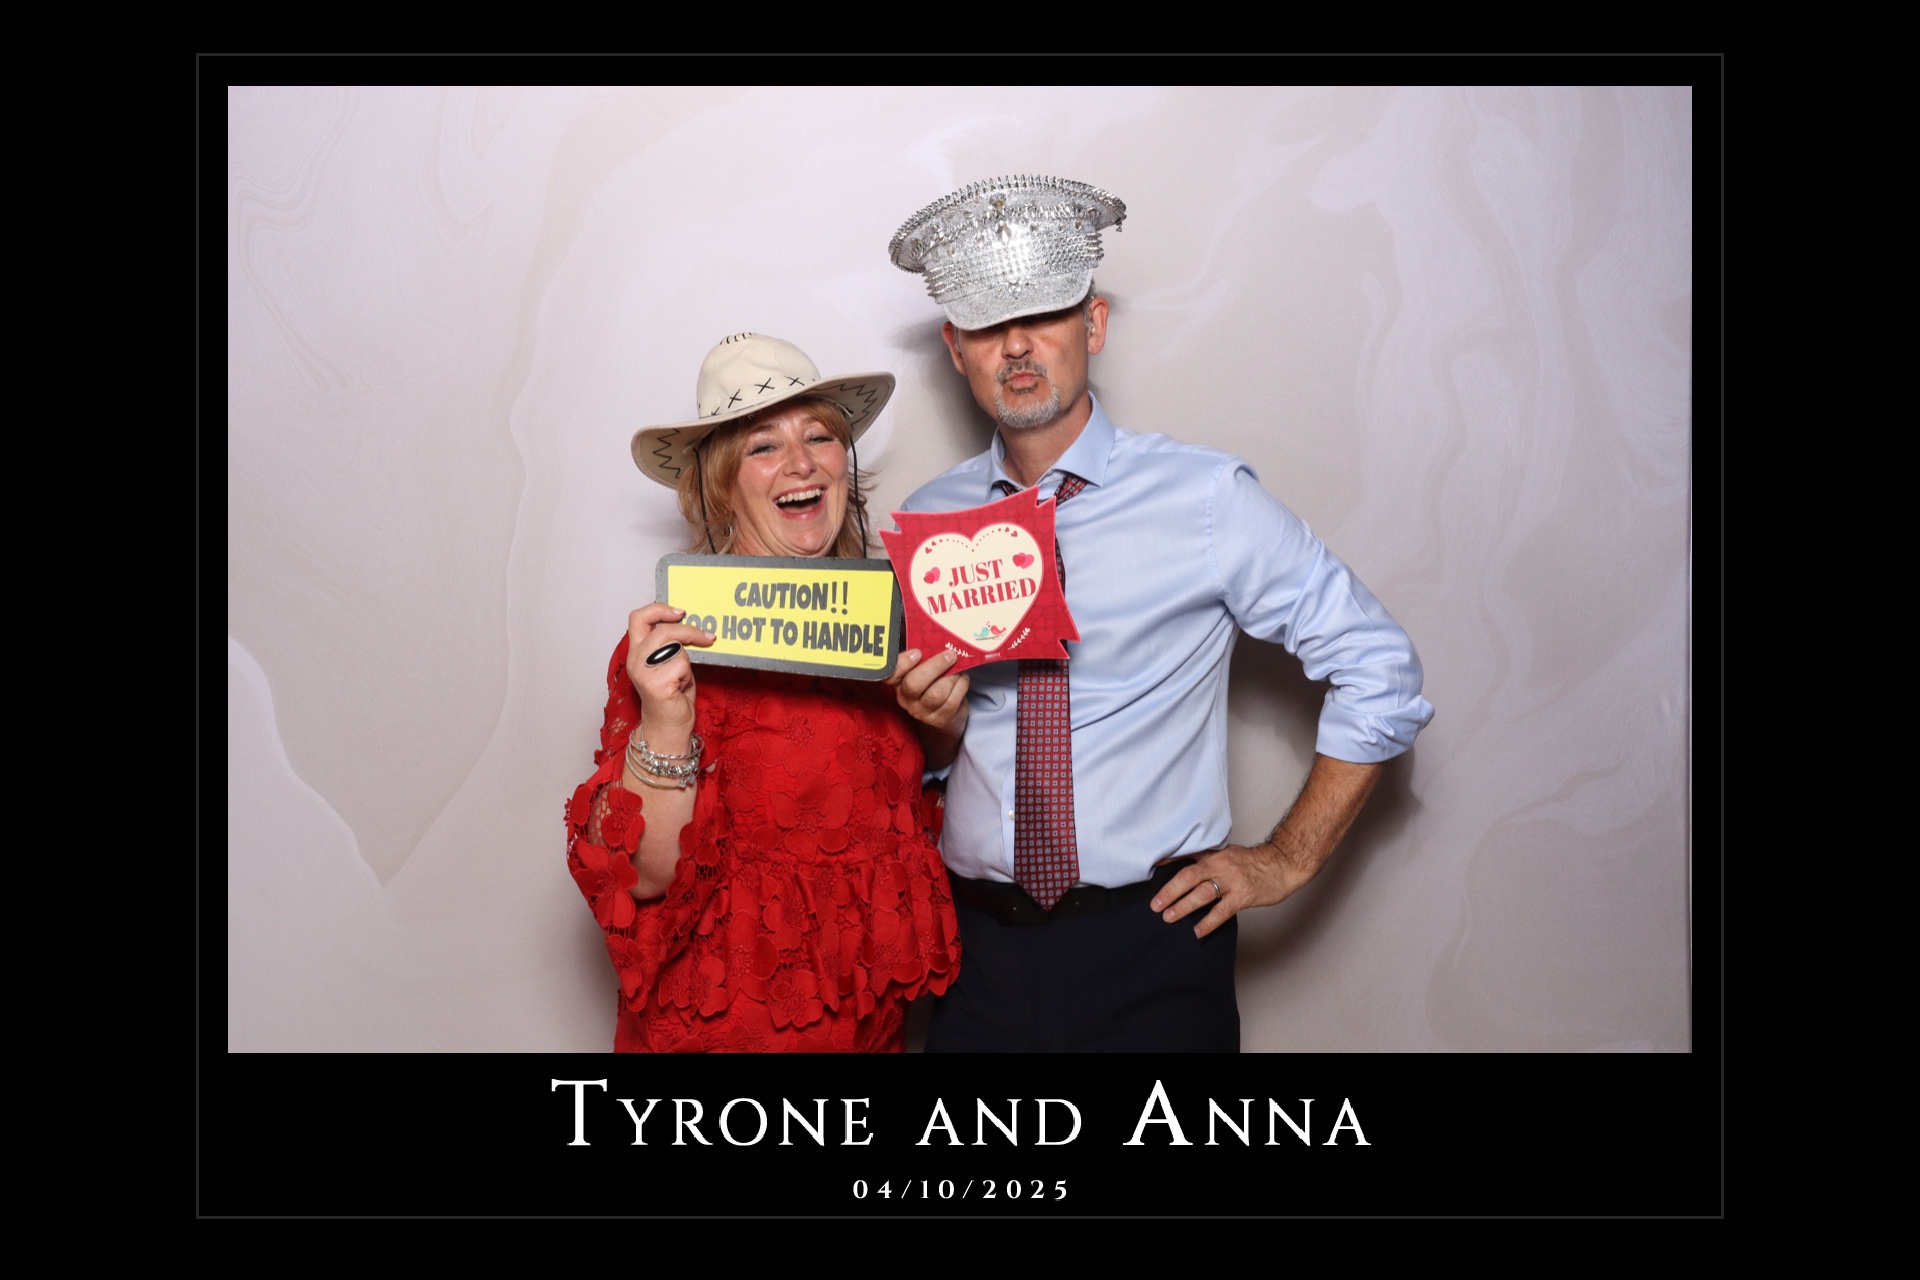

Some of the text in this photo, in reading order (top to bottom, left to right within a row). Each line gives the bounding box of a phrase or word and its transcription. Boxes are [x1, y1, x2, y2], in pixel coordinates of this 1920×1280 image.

[949, 559, 1003, 587] JUST
[734, 581, 848, 615] CAUTION!!
[926, 577, 1036, 615] MARRIED
[681, 613, 885, 657] OO HOT TO HANDLE
